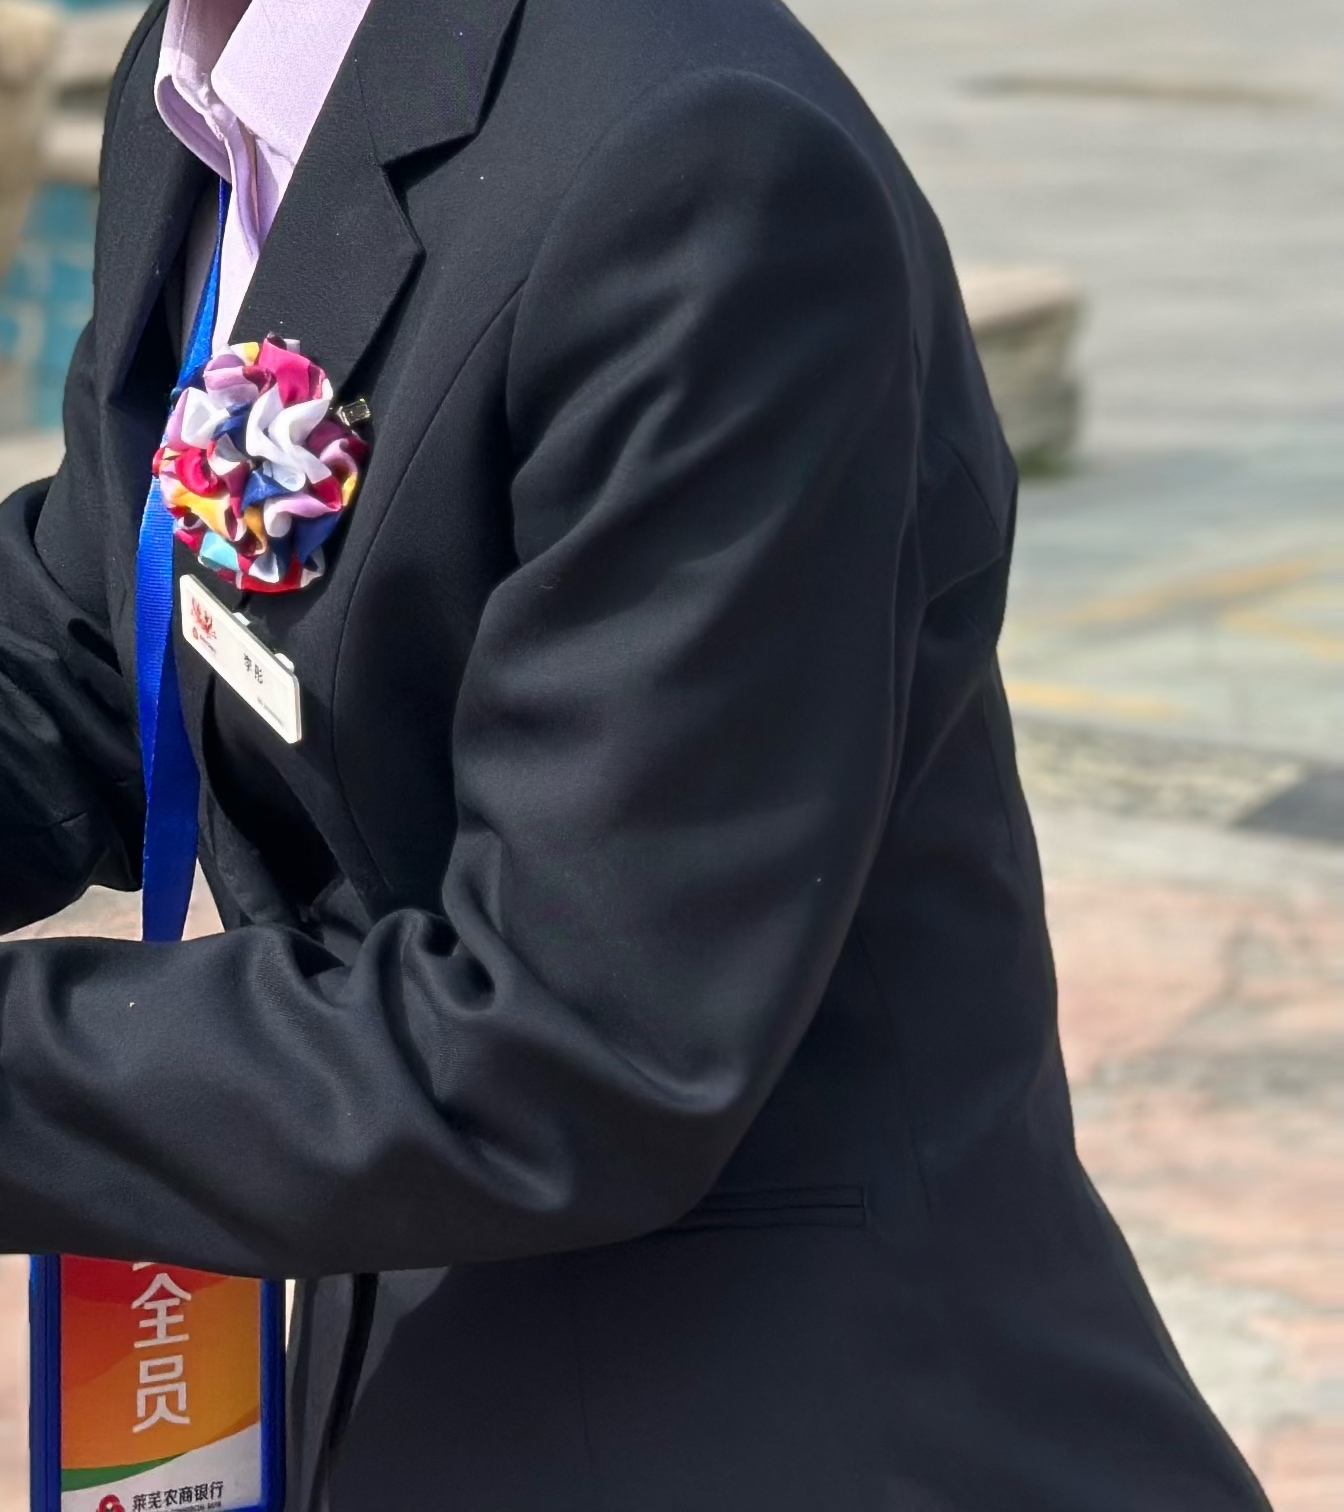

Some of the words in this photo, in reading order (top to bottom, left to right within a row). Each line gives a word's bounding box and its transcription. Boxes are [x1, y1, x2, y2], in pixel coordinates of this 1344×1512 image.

[131, 1261, 192, 1434] 全员
[132, 1480, 224, 1512] 莱芜农商银行
